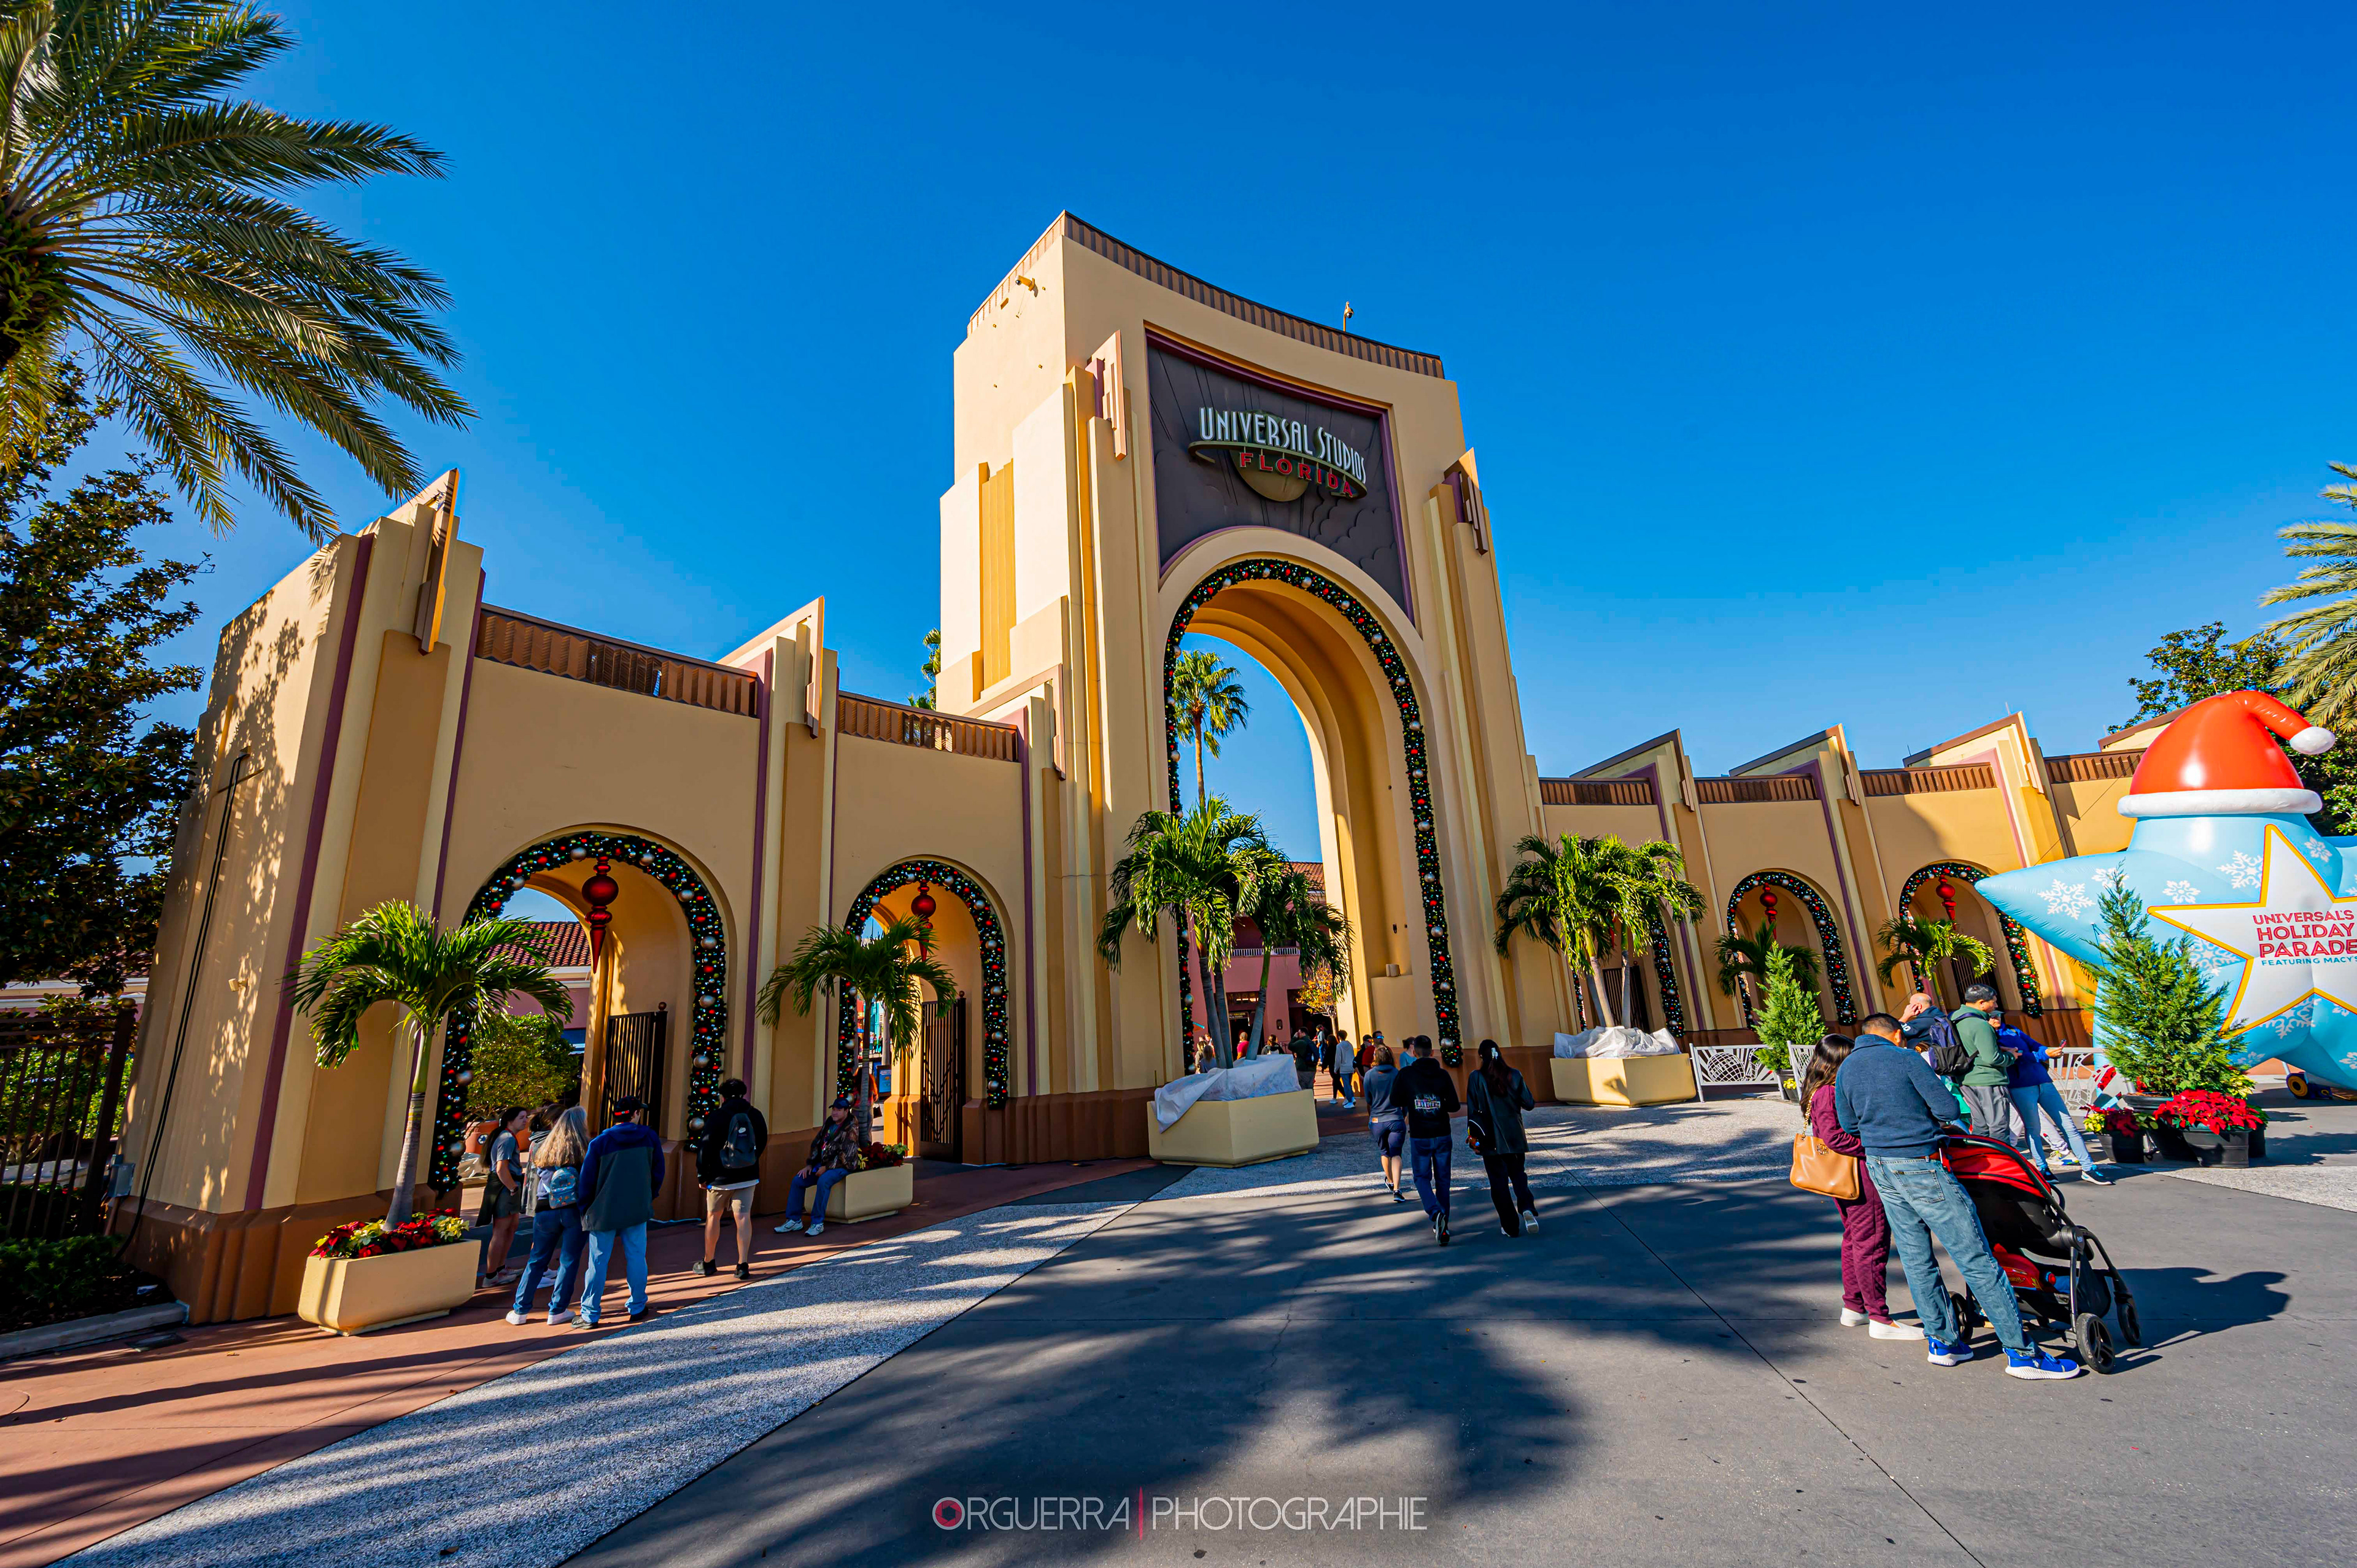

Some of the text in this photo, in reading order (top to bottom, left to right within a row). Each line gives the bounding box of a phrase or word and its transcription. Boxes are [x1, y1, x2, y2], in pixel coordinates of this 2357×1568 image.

[1199, 407, 1366, 484] UNIVERSAL STUDIOS
[1239, 452, 1353, 498] FLORIDA
[2252, 910, 2355, 925] UNIVERSAL'S
[2256, 922, 2355, 941] HOLIDAY
[2259, 939, 2357, 958] PARADE
